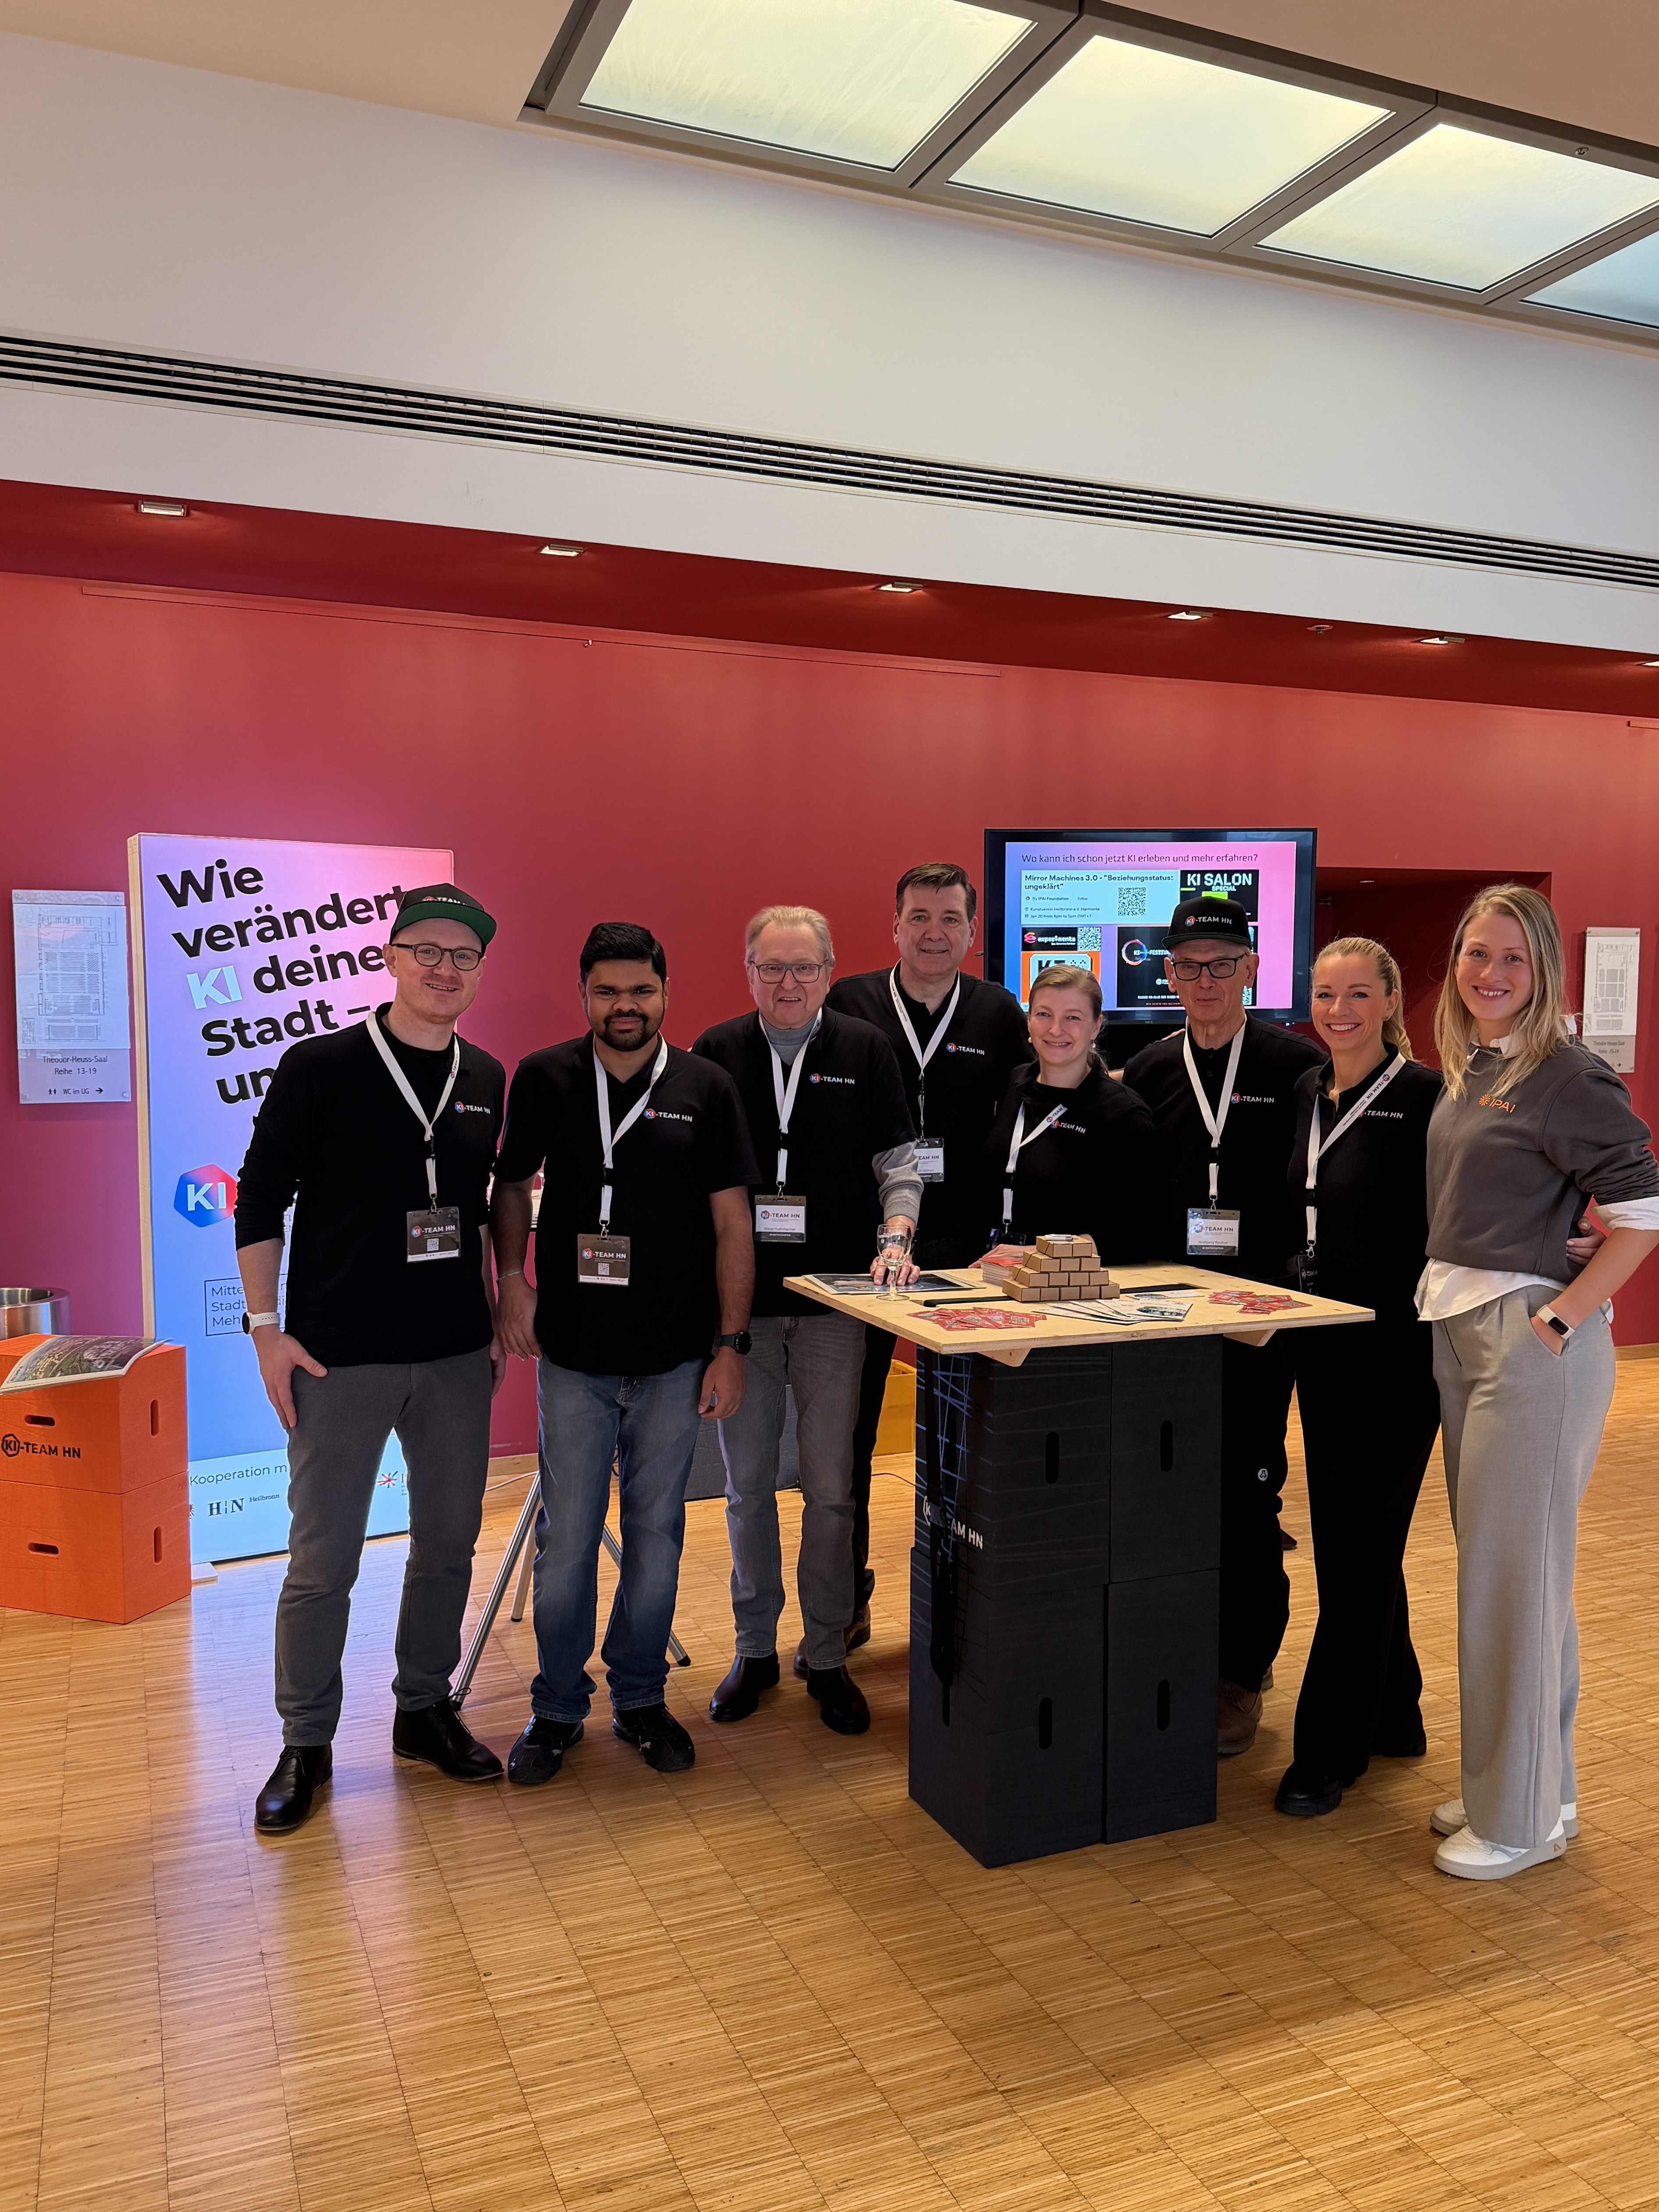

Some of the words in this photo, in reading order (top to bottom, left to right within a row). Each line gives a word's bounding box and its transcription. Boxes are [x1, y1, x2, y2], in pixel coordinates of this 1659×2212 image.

[1105, 855, 1125, 864] jetzt
[156, 859, 263, 908] Wie
[1187, 873, 1200, 886] KI
[1204, 873, 1252, 885] SALON
[171, 885, 406, 958] verändert
[1187, 916, 1219, 925] KI-TEAM
[187, 965, 242, 1009] KI
[253, 944, 384, 994] deine
[201, 1000, 340, 1057] Stadt
[811, 1075, 842, 1083] KI-TEAM
[1489, 1098, 1516, 1113] IPAI
[646, 1110, 679, 1119] KI-TEAM
[187, 1182, 227, 1211] KI
[413, 1226, 444, 1234] KI-TEAM
[5, 1439, 58, 1456] KI-TEAM
[63, 1447, 81, 1459] HN
[190, 1466, 270, 1486] Kooperation
[249, 1493, 280, 1502] Heilbronn
[969, 1528, 983, 1549] HN
